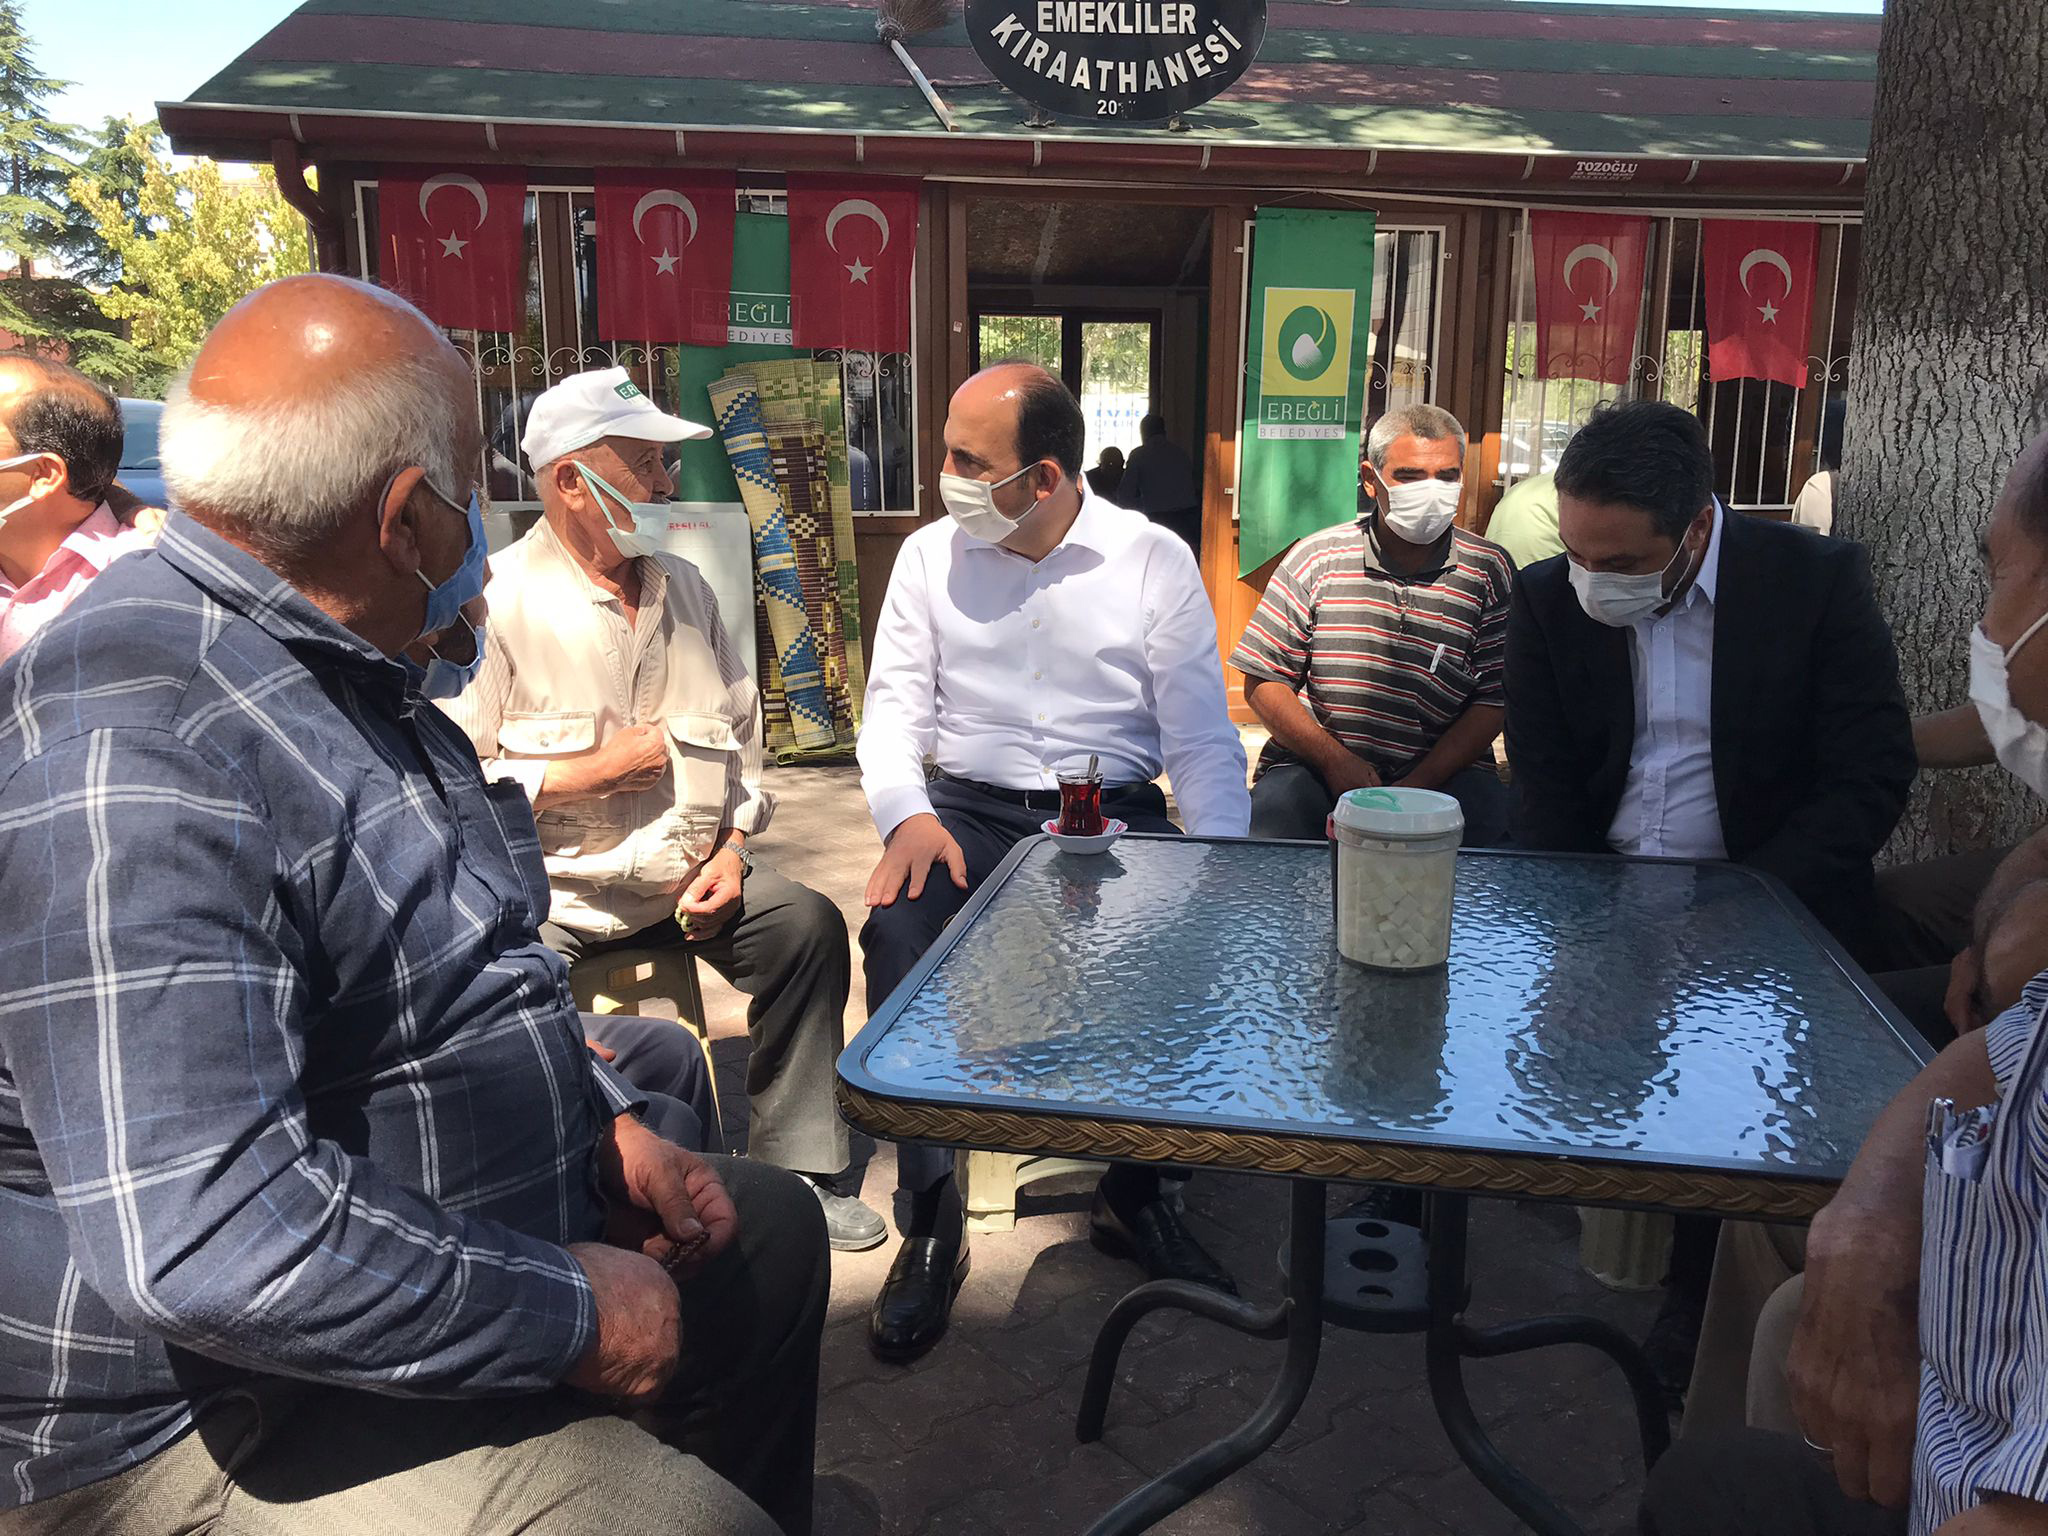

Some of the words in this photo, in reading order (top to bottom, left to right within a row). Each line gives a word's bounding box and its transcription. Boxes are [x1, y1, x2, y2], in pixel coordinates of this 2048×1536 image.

[1037, 0, 1196, 34] EMEKLİLER
[990, 13, 1242, 94] KIRAATHANESİ
[1577, 160, 1638, 173] TOZOĞLU
[619, 384, 641, 398] ER
